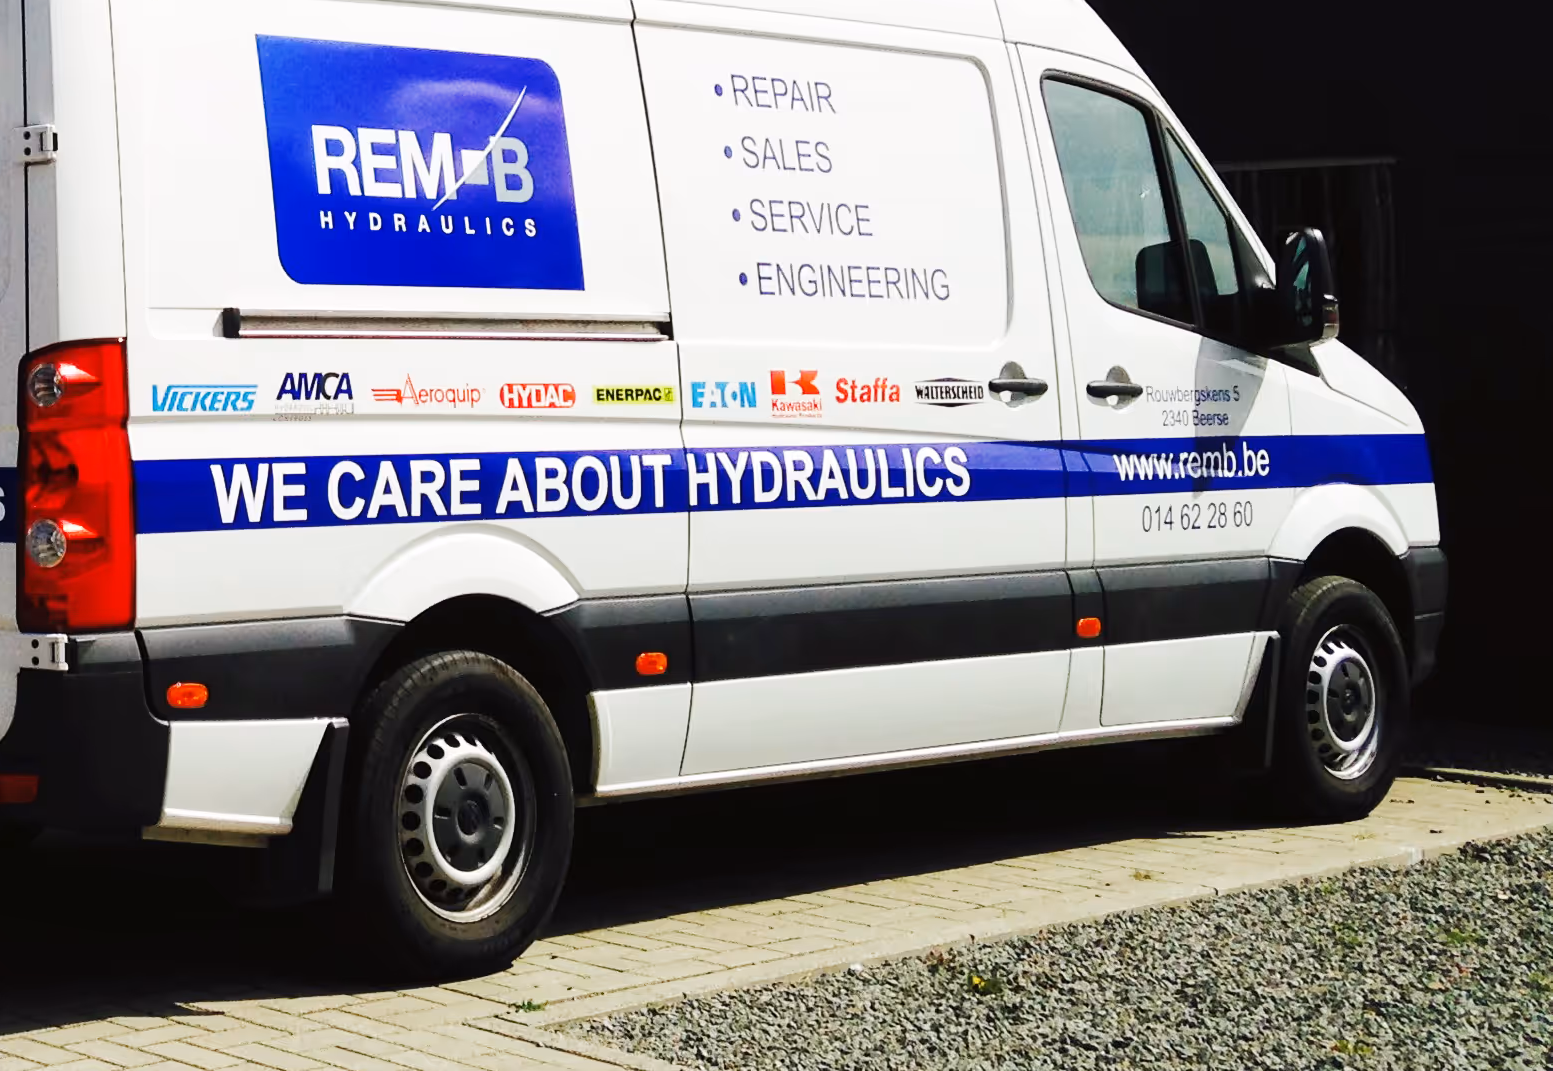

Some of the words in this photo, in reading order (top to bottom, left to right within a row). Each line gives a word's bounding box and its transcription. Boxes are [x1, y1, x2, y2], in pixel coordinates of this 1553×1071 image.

[730, 74, 837, 113] REPAIR
[741, 136, 833, 173] SALES
[319, 210, 538, 238] HYDRAULICS
[749, 198, 873, 237] SERVICE
[756, 262, 950, 301] ENGINEERING
[152, 384, 258, 412] VICKERS
[276, 372, 354, 401] AMCA
[401, 373, 482, 409] Aeroquip
[503, 384, 574, 408] HYDAC
[596, 387, 662, 402] ENERPAC
[691, 381, 757, 408] EATON
[835, 377, 901, 404] Staffa
[914, 385, 984, 400] WALTERSCHEID
[1146, 385, 1231, 406] Rouwbergskens
[1232, 385, 1241, 401] 5
[771, 398, 823, 412] Kawasaki
[1162, 410, 1189, 426] 2340
[1192, 410, 1230, 426] Beerse
[1113, 441, 1270, 481] www.remb.be
[209, 461, 308, 524] WE
[327, 459, 482, 520] CARE
[495, 454, 673, 514] ABOUT
[687, 446, 971, 506] HYDRAULICS
[1141, 505, 1175, 532] 014
[1180, 503, 1201, 530] 62
[1207, 502, 1227, 528] 28
[1233, 500, 1253, 527] 60
